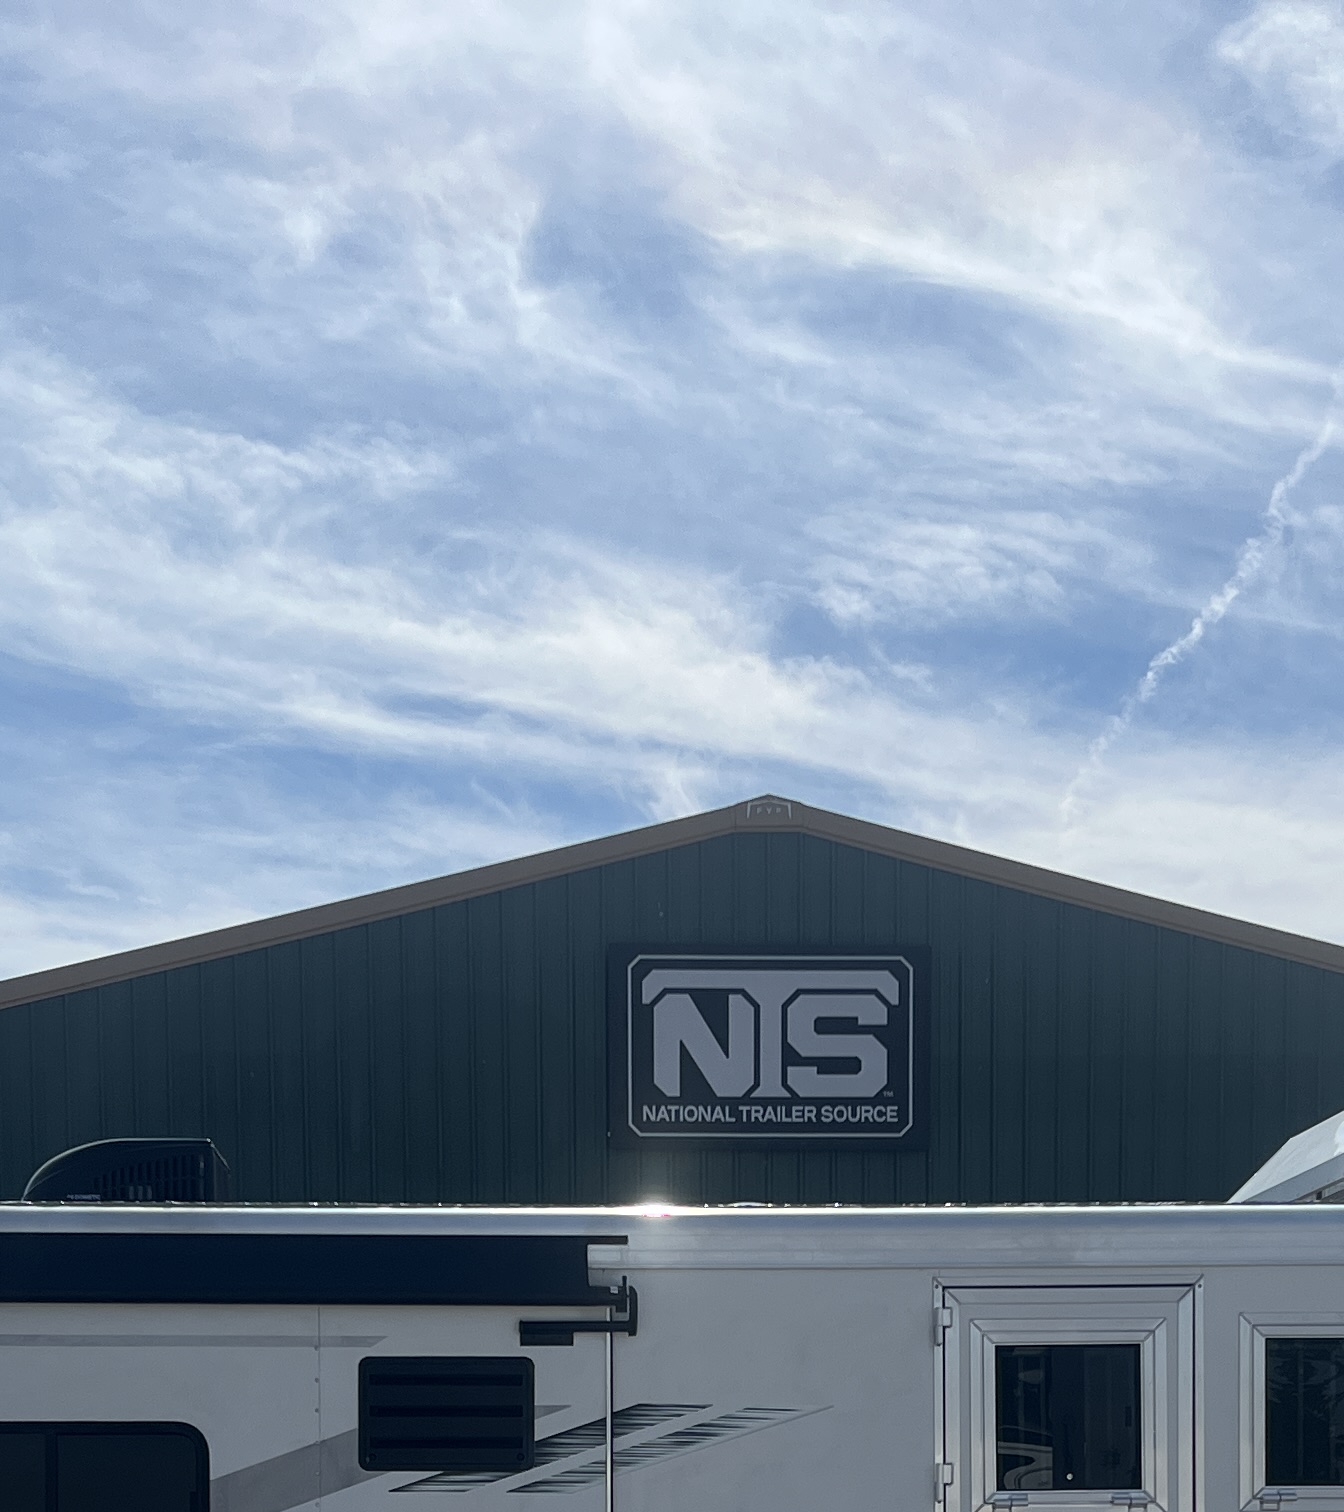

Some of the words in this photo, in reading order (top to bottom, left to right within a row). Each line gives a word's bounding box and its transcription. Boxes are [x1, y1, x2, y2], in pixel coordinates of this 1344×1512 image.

[642, 969, 899, 1098] NTS
[642, 1105, 735, 1122] NATIONAL
[739, 1105, 817, 1122] TRAILER
[821, 1105, 899, 1123] SOURCE
